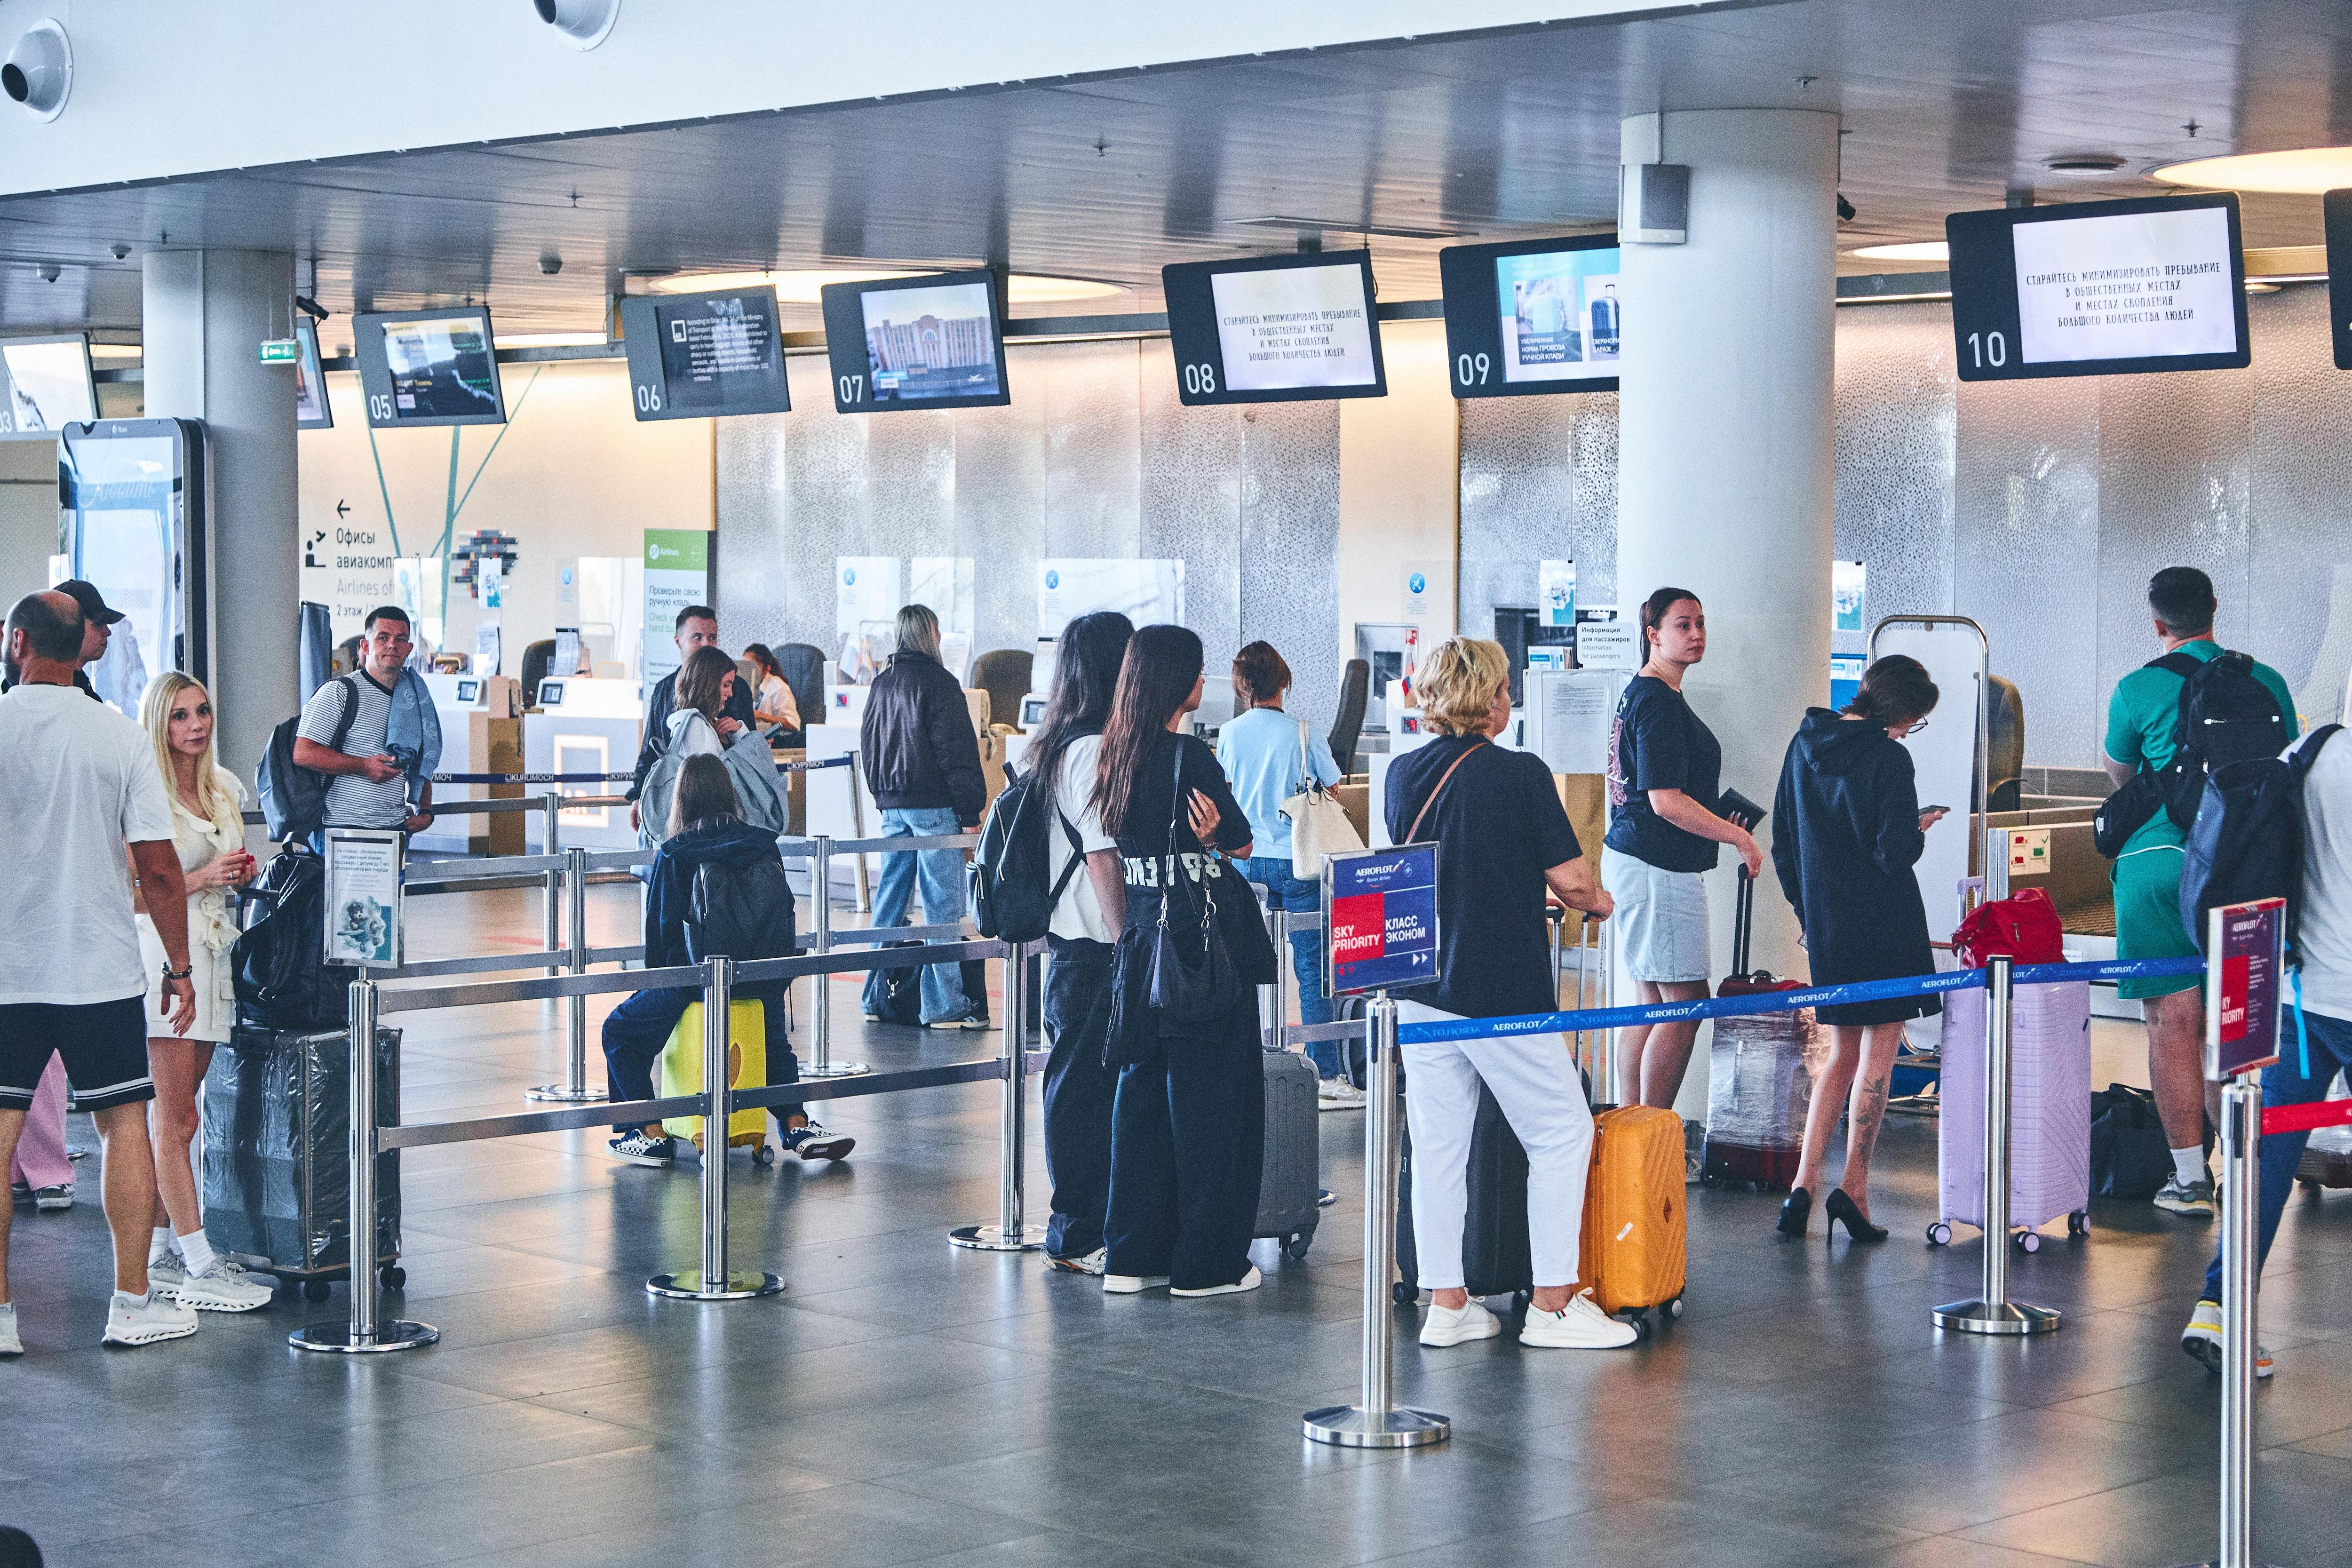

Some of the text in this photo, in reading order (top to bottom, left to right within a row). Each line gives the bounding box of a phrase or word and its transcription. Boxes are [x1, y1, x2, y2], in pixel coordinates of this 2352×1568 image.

[2026, 262, 2221, 285] СТАРАЙТЕСЬ МИНИМИЗИРОВАТЬ ПРЕБЫВАНИЕ
[2066, 280, 2181, 297] В ОБЩЕСТВЕННЫХ МЕСТАХ
[2075, 296, 2173, 311] И МЕСТАХ СКОПЛЕНИЯ
[1224, 309, 1361, 326] СТАРАЙТЕСЬ МИНИМИЗИРОВАТЬ ПРЕБЫВАНИЕ
[2058, 309, 2194, 327] БОЛЬШОГО КОЛИЧЕСТВА ЛЮДЕЙ
[1259, 325, 1306, 336] ОБЩЕСТВЕННЫХ
[1311, 323, 1334, 332] МЕСТАХ
[1260, 336, 1330, 348] И МЕСТАХ СКОПЛЕНИЯ
[1520, 336, 1554, 346] УВЕЛИЧЕННАЯ
[1248, 347, 1345, 361] БОЛЬШОГО КОЛИЧЕСТВА ЛЮДЕЙ
[1539, 344, 1566, 353] ПРОВОЗА
[1968, 331, 2006, 368] 10
[1522, 352, 1565, 362] РУЧНОЙ КЛАДИ
[1458, 352, 1490, 386] 09
[1185, 363, 1216, 394] 08
[840, 375, 863, 403] 07
[637, 384, 661, 413] 06
[370, 394, 392, 420] 05
[336, 527, 375, 549] Офисы
[336, 579, 378, 595] Airlines
[649, 585, 682, 597] Проверьте
[649, 598, 671, 607] ручную
[337, 604, 341, 616] 2
[344, 606, 363, 616] этаж
[649, 612, 667, 621] Check
[649, 624, 664, 633] hand
[792, 760, 824, 769] КУРУМОЧ
[511, 772, 554, 781] KURUMOCH
[1356, 865, 1393, 876] AEROFLOT
[1385, 915, 1418, 931] КЛАСС
[2233, 919, 2257, 932] AEROFLOT
[1334, 924, 1355, 939] SKY
[1386, 927, 1426, 943] ЭКОНОМ
[1334, 933, 1381, 951] PRIORITY
[2099, 965, 2132, 975] AEROFLOT
[1922, 977, 1961, 989] AEROFLOT
[1788, 992, 1830, 1004] AEROFLOT
[1644, 1007, 1690, 1019] AEROFLOT
[1492, 1019, 1541, 1032] AEROFLOT
